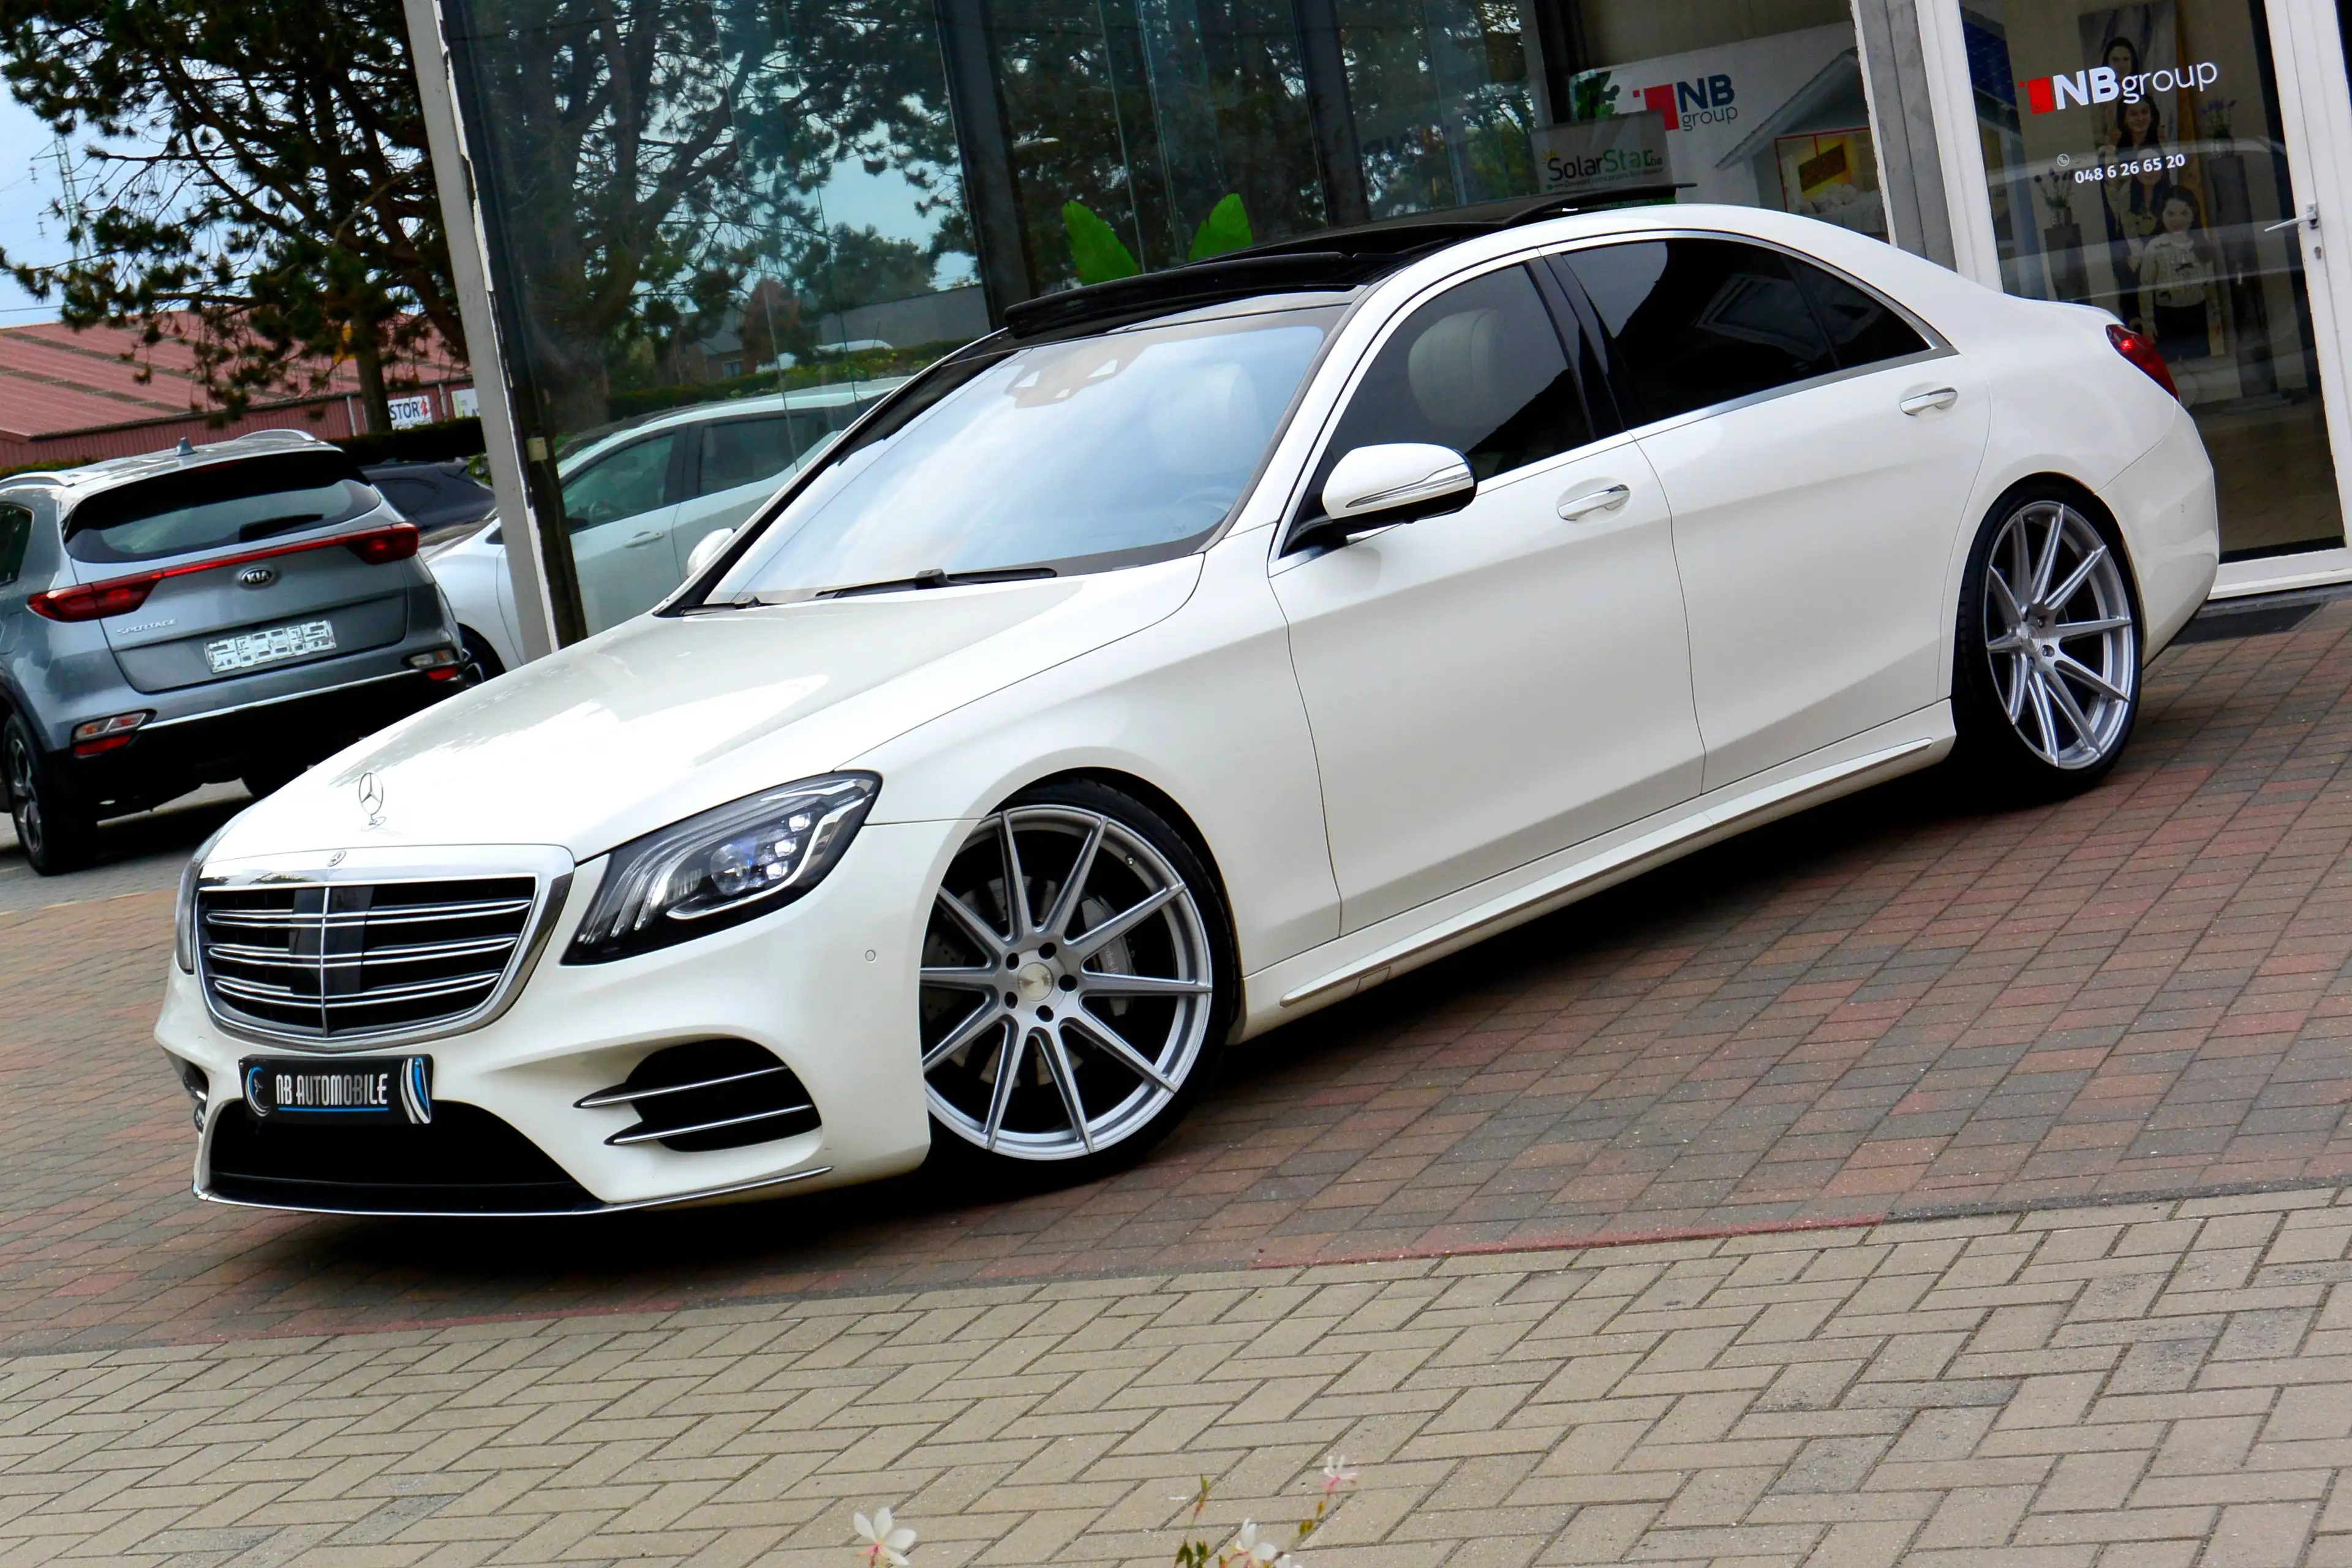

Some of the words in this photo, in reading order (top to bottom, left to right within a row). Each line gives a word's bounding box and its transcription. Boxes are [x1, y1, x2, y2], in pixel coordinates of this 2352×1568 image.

[1676, 74, 1735, 113] NB
[1682, 107, 1738, 132] group
[2075, 167, 2103, 184] 048
[2107, 165, 2117, 178] 6
[2120, 162, 2139, 176] 26
[2143, 157, 2162, 172] 65
[2166, 153, 2185, 169] 20
[246, 570, 270, 583] KIA
[276, 1074, 292, 1105] NB
[296, 1073, 388, 1106] AUTOMOBILE
